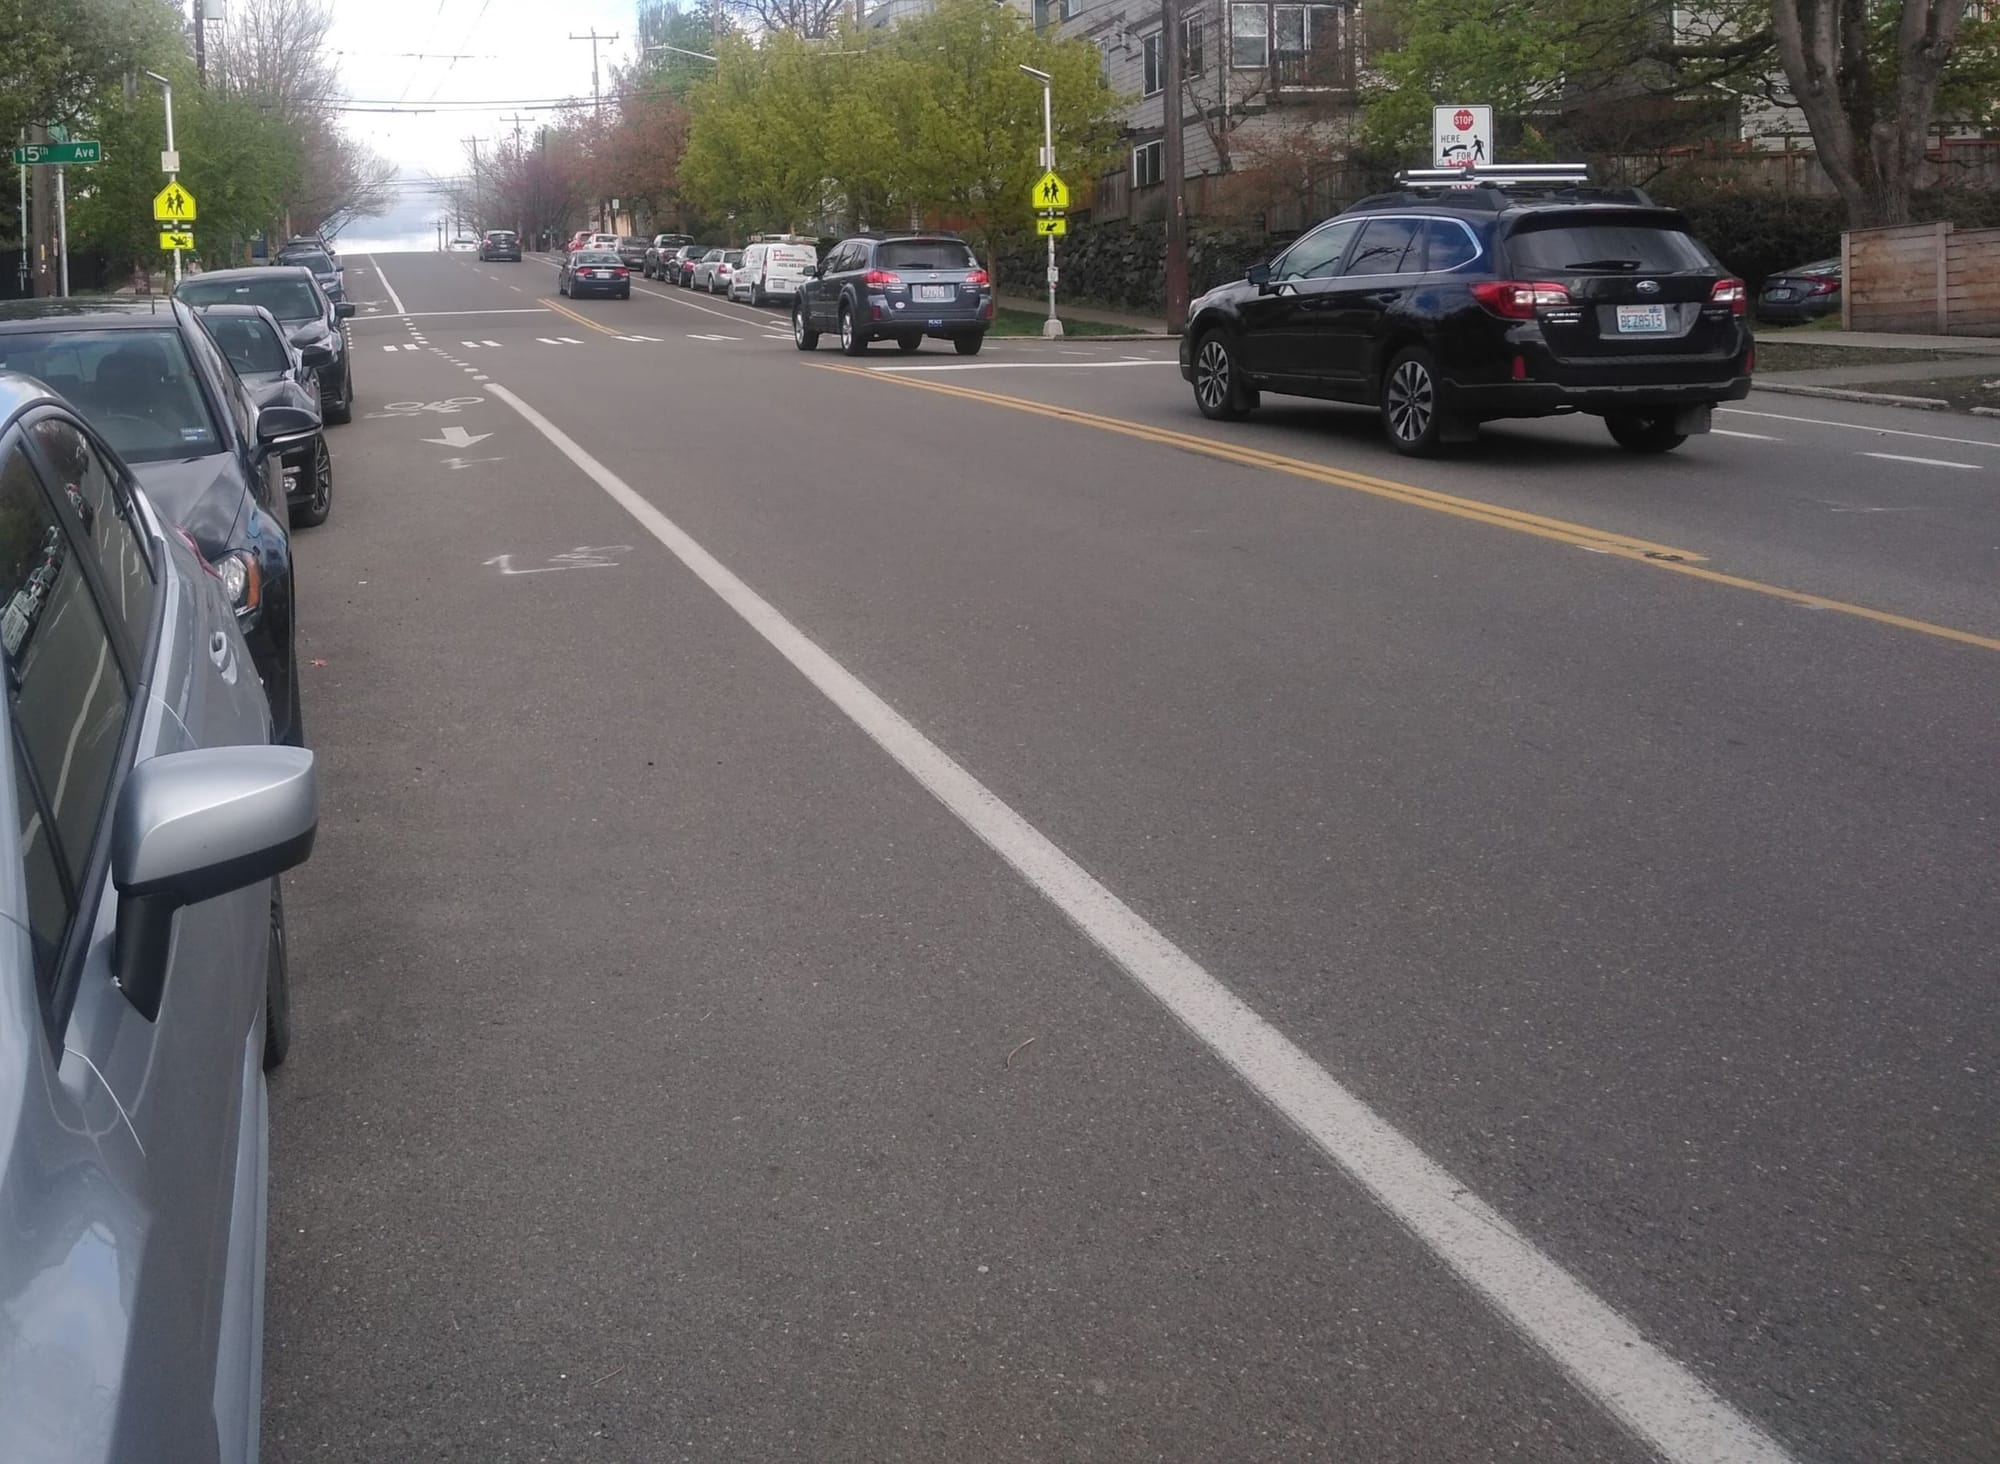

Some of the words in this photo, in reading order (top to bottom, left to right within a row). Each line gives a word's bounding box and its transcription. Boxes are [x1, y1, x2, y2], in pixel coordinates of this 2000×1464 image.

[1454, 116, 1473, 125] STOP
[1440, 134, 1461, 143] HERE
[20, 146, 49, 162] 15th
[74, 147, 95, 158] Ave
[1456, 152, 1472, 160] FOR
